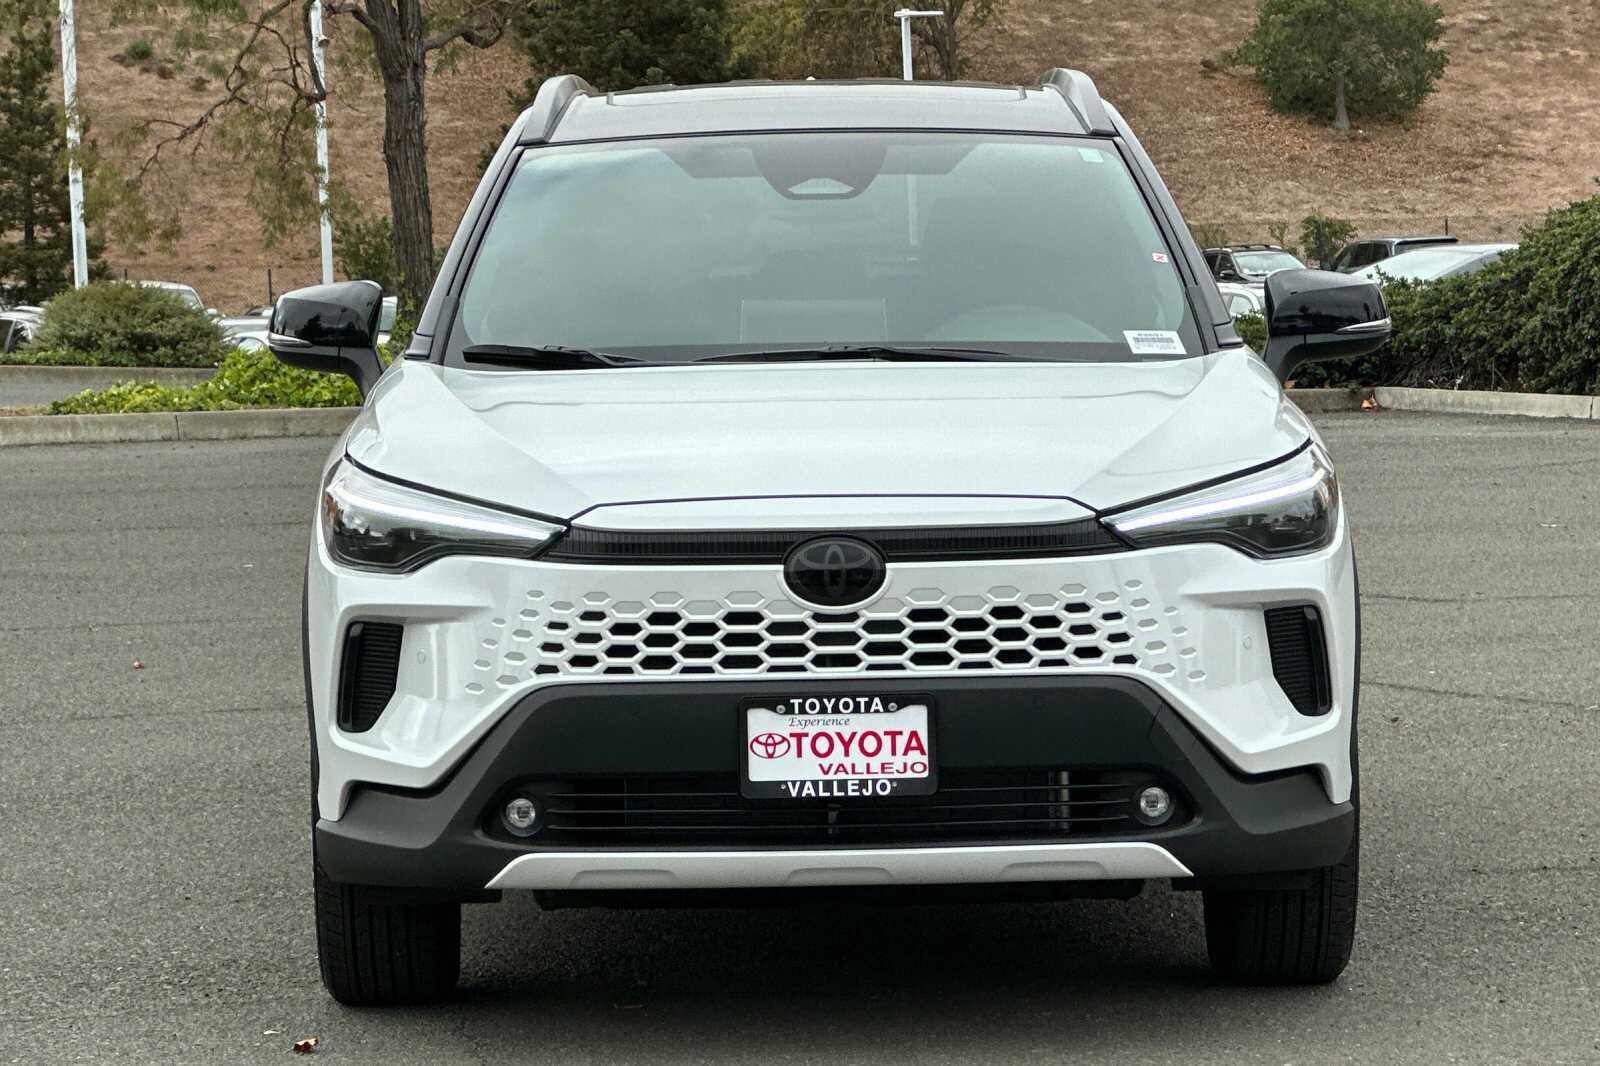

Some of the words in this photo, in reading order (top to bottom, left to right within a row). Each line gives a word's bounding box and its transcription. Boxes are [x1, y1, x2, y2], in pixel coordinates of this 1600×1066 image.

[790, 698, 884, 714] TOYOTA
[788, 717, 850, 729] Experience
[789, 730, 927, 759] TOYOTA
[818, 761, 928, 776] VALLEJO
[787, 779, 891, 797] VALLEJO
